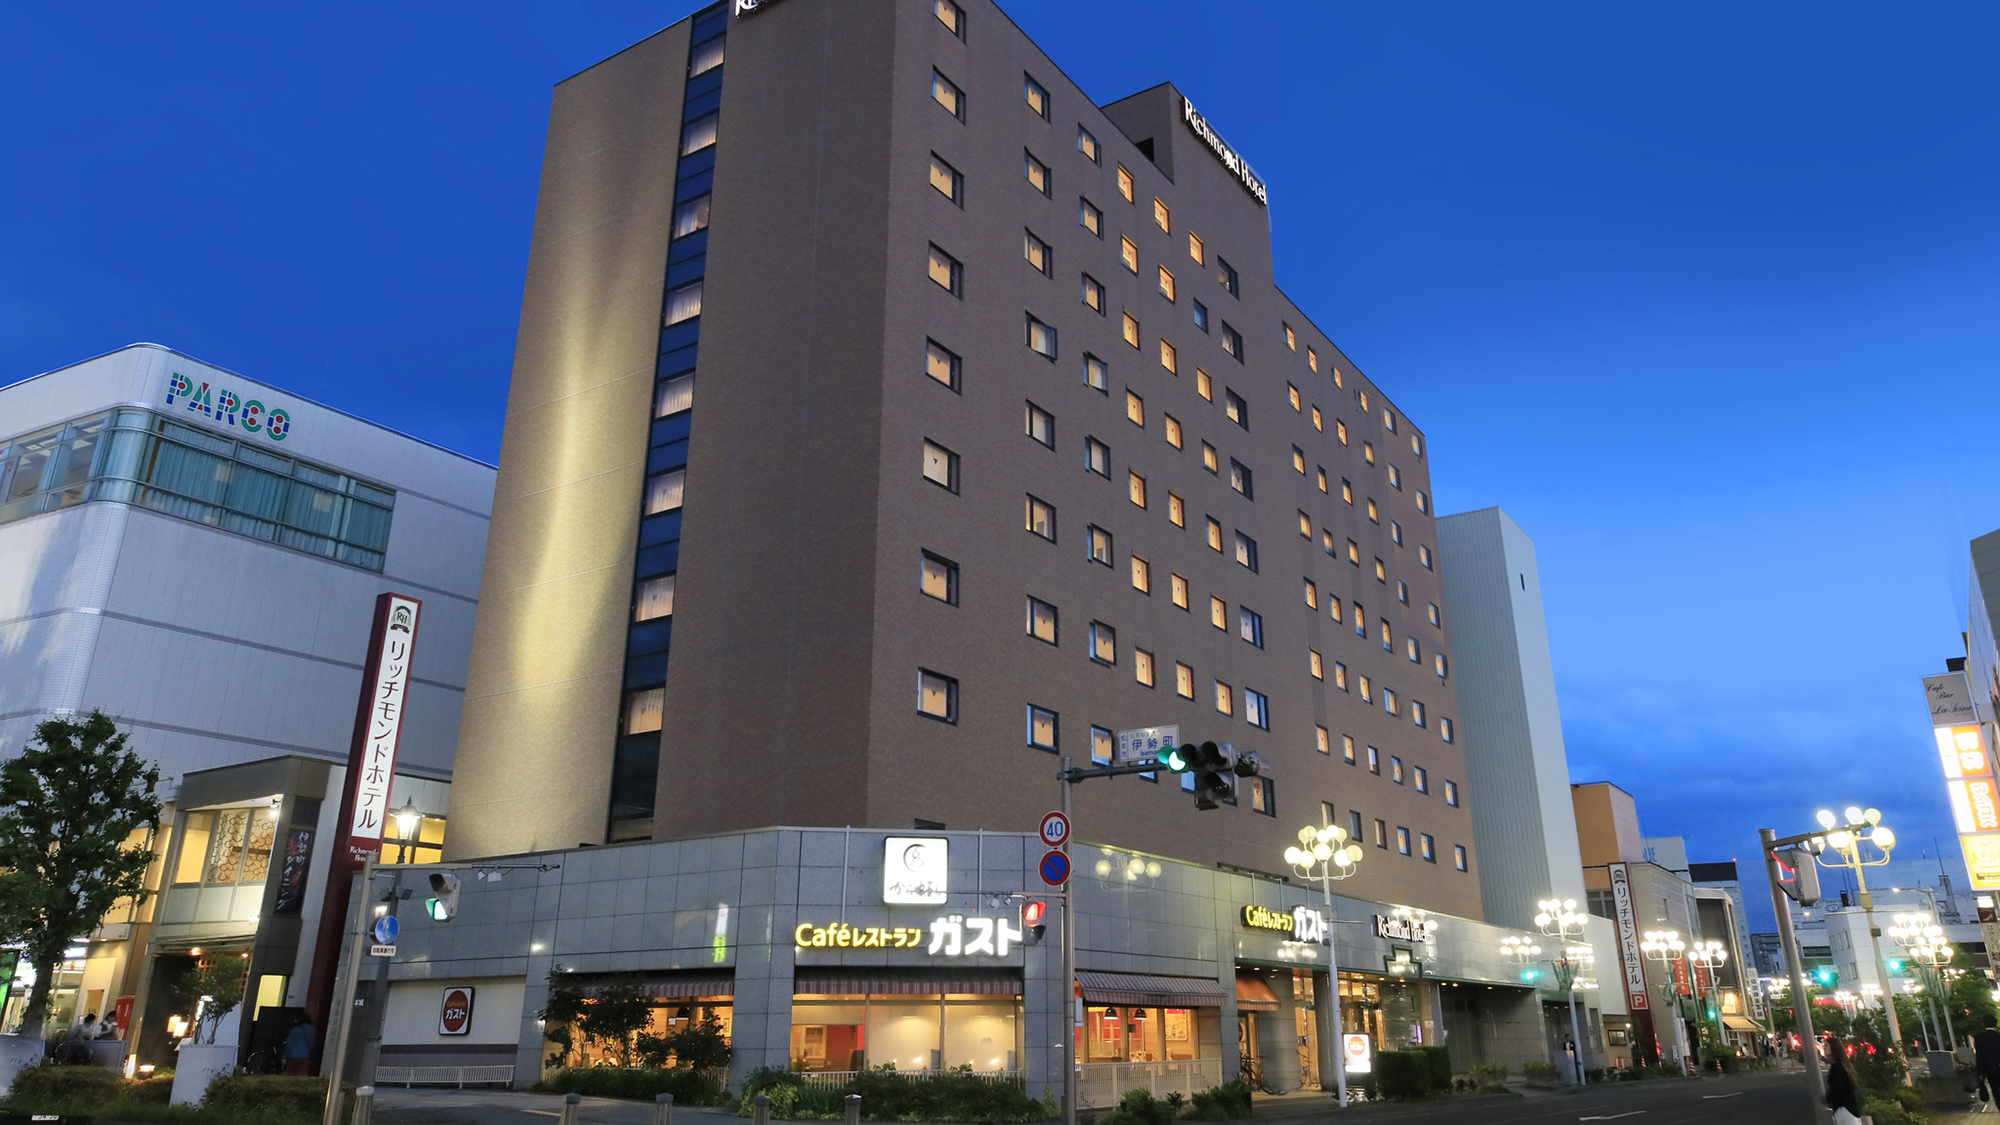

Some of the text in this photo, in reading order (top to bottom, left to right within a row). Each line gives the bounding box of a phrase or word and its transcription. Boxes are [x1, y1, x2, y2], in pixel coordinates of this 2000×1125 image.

[1183, 96, 1267, 205] Richmond Hotel
[166, 372, 290, 441] PARCO
[357, 640, 405, 829] リッチモンドホテル
[1132, 735, 1173, 751] 伊勢町
[1046, 821, 1064, 837] 40
[929, 915, 1022, 956] ガスト
[1617, 887, 1641, 985] リッチモンドホテル
[445, 1008, 466, 1020] ガスト
[1634, 996, 1644, 1006] P
